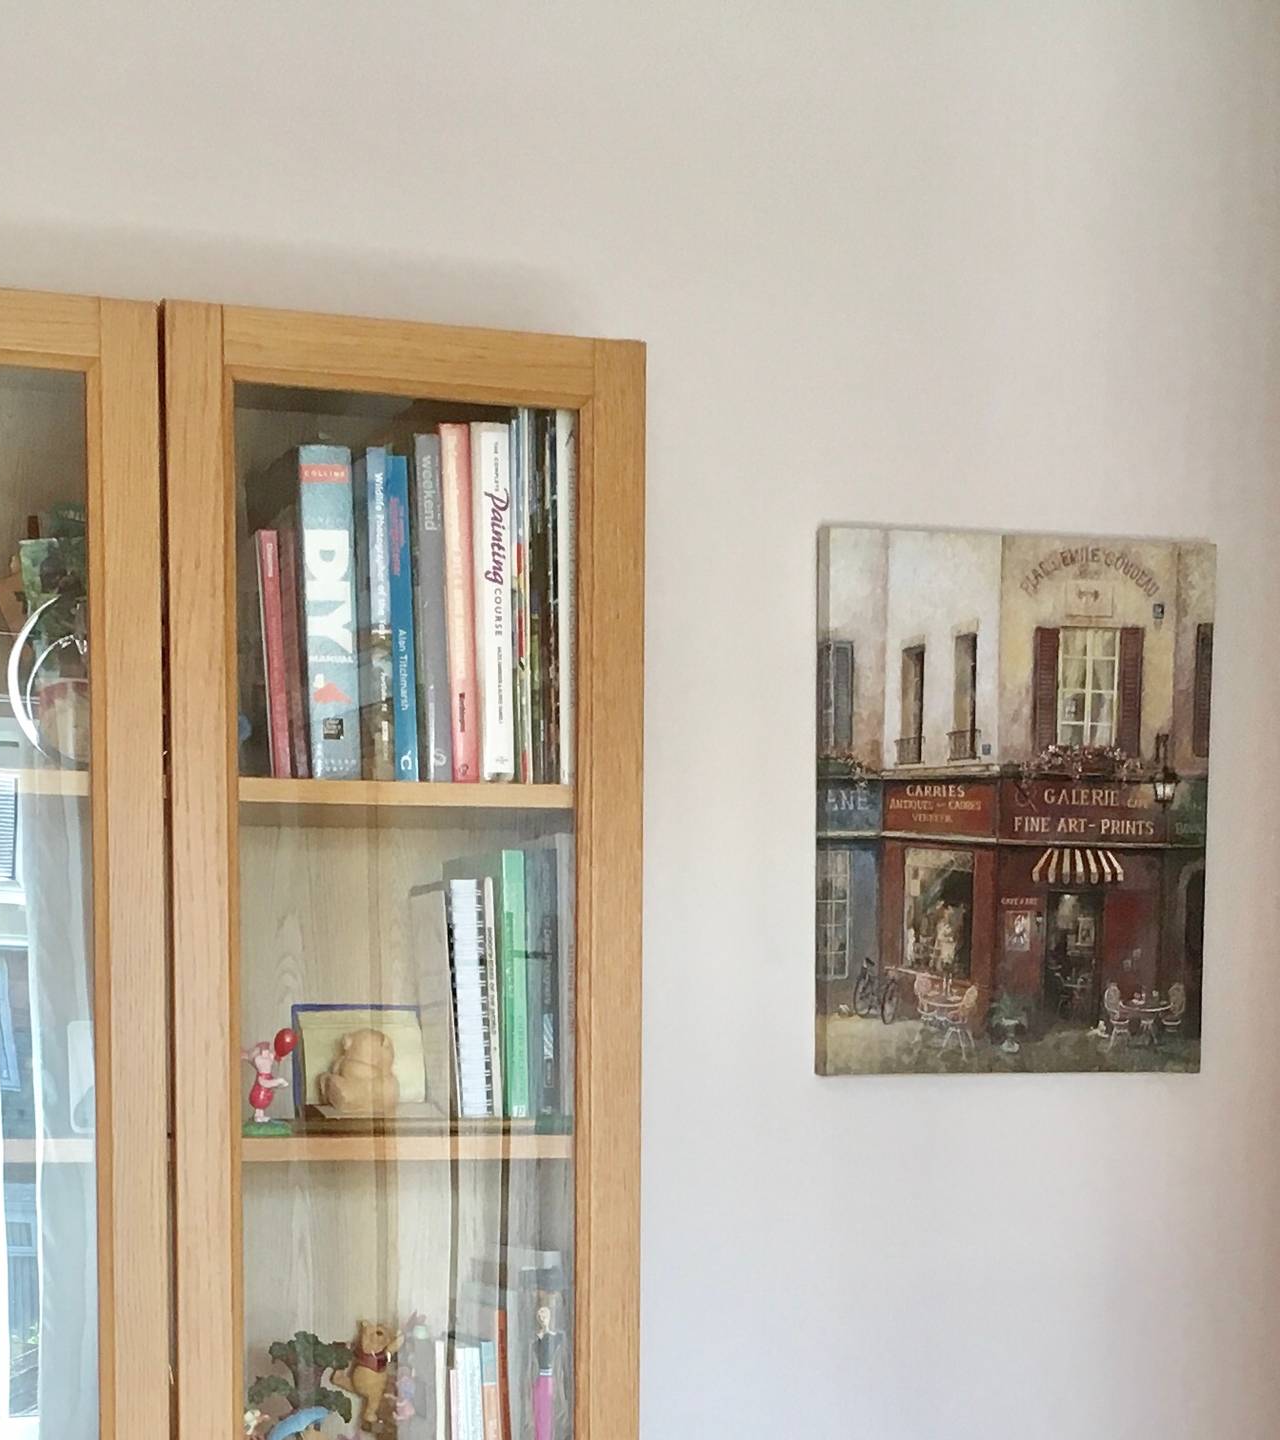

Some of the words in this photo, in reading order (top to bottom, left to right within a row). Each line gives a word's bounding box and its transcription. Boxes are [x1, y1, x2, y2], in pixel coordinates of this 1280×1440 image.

[375, 472, 385, 511] Wildlife
[422, 456, 438, 531] weekend
[374, 514, 386, 583] Photographer
[484, 488, 510, 586] Painting
[303, 529, 354, 654] DIY
[494, 586, 503, 637] COURSE
[309, 655, 354, 664] MANUAL
[397, 629, 408, 652] Alan
[399, 655, 410, 711] Titchmarsh
[1043, 788, 1120, 808] GALERIE
[1013, 815, 1051, 834] FINE
[1099, 818, 1154, 836] PRINTS
